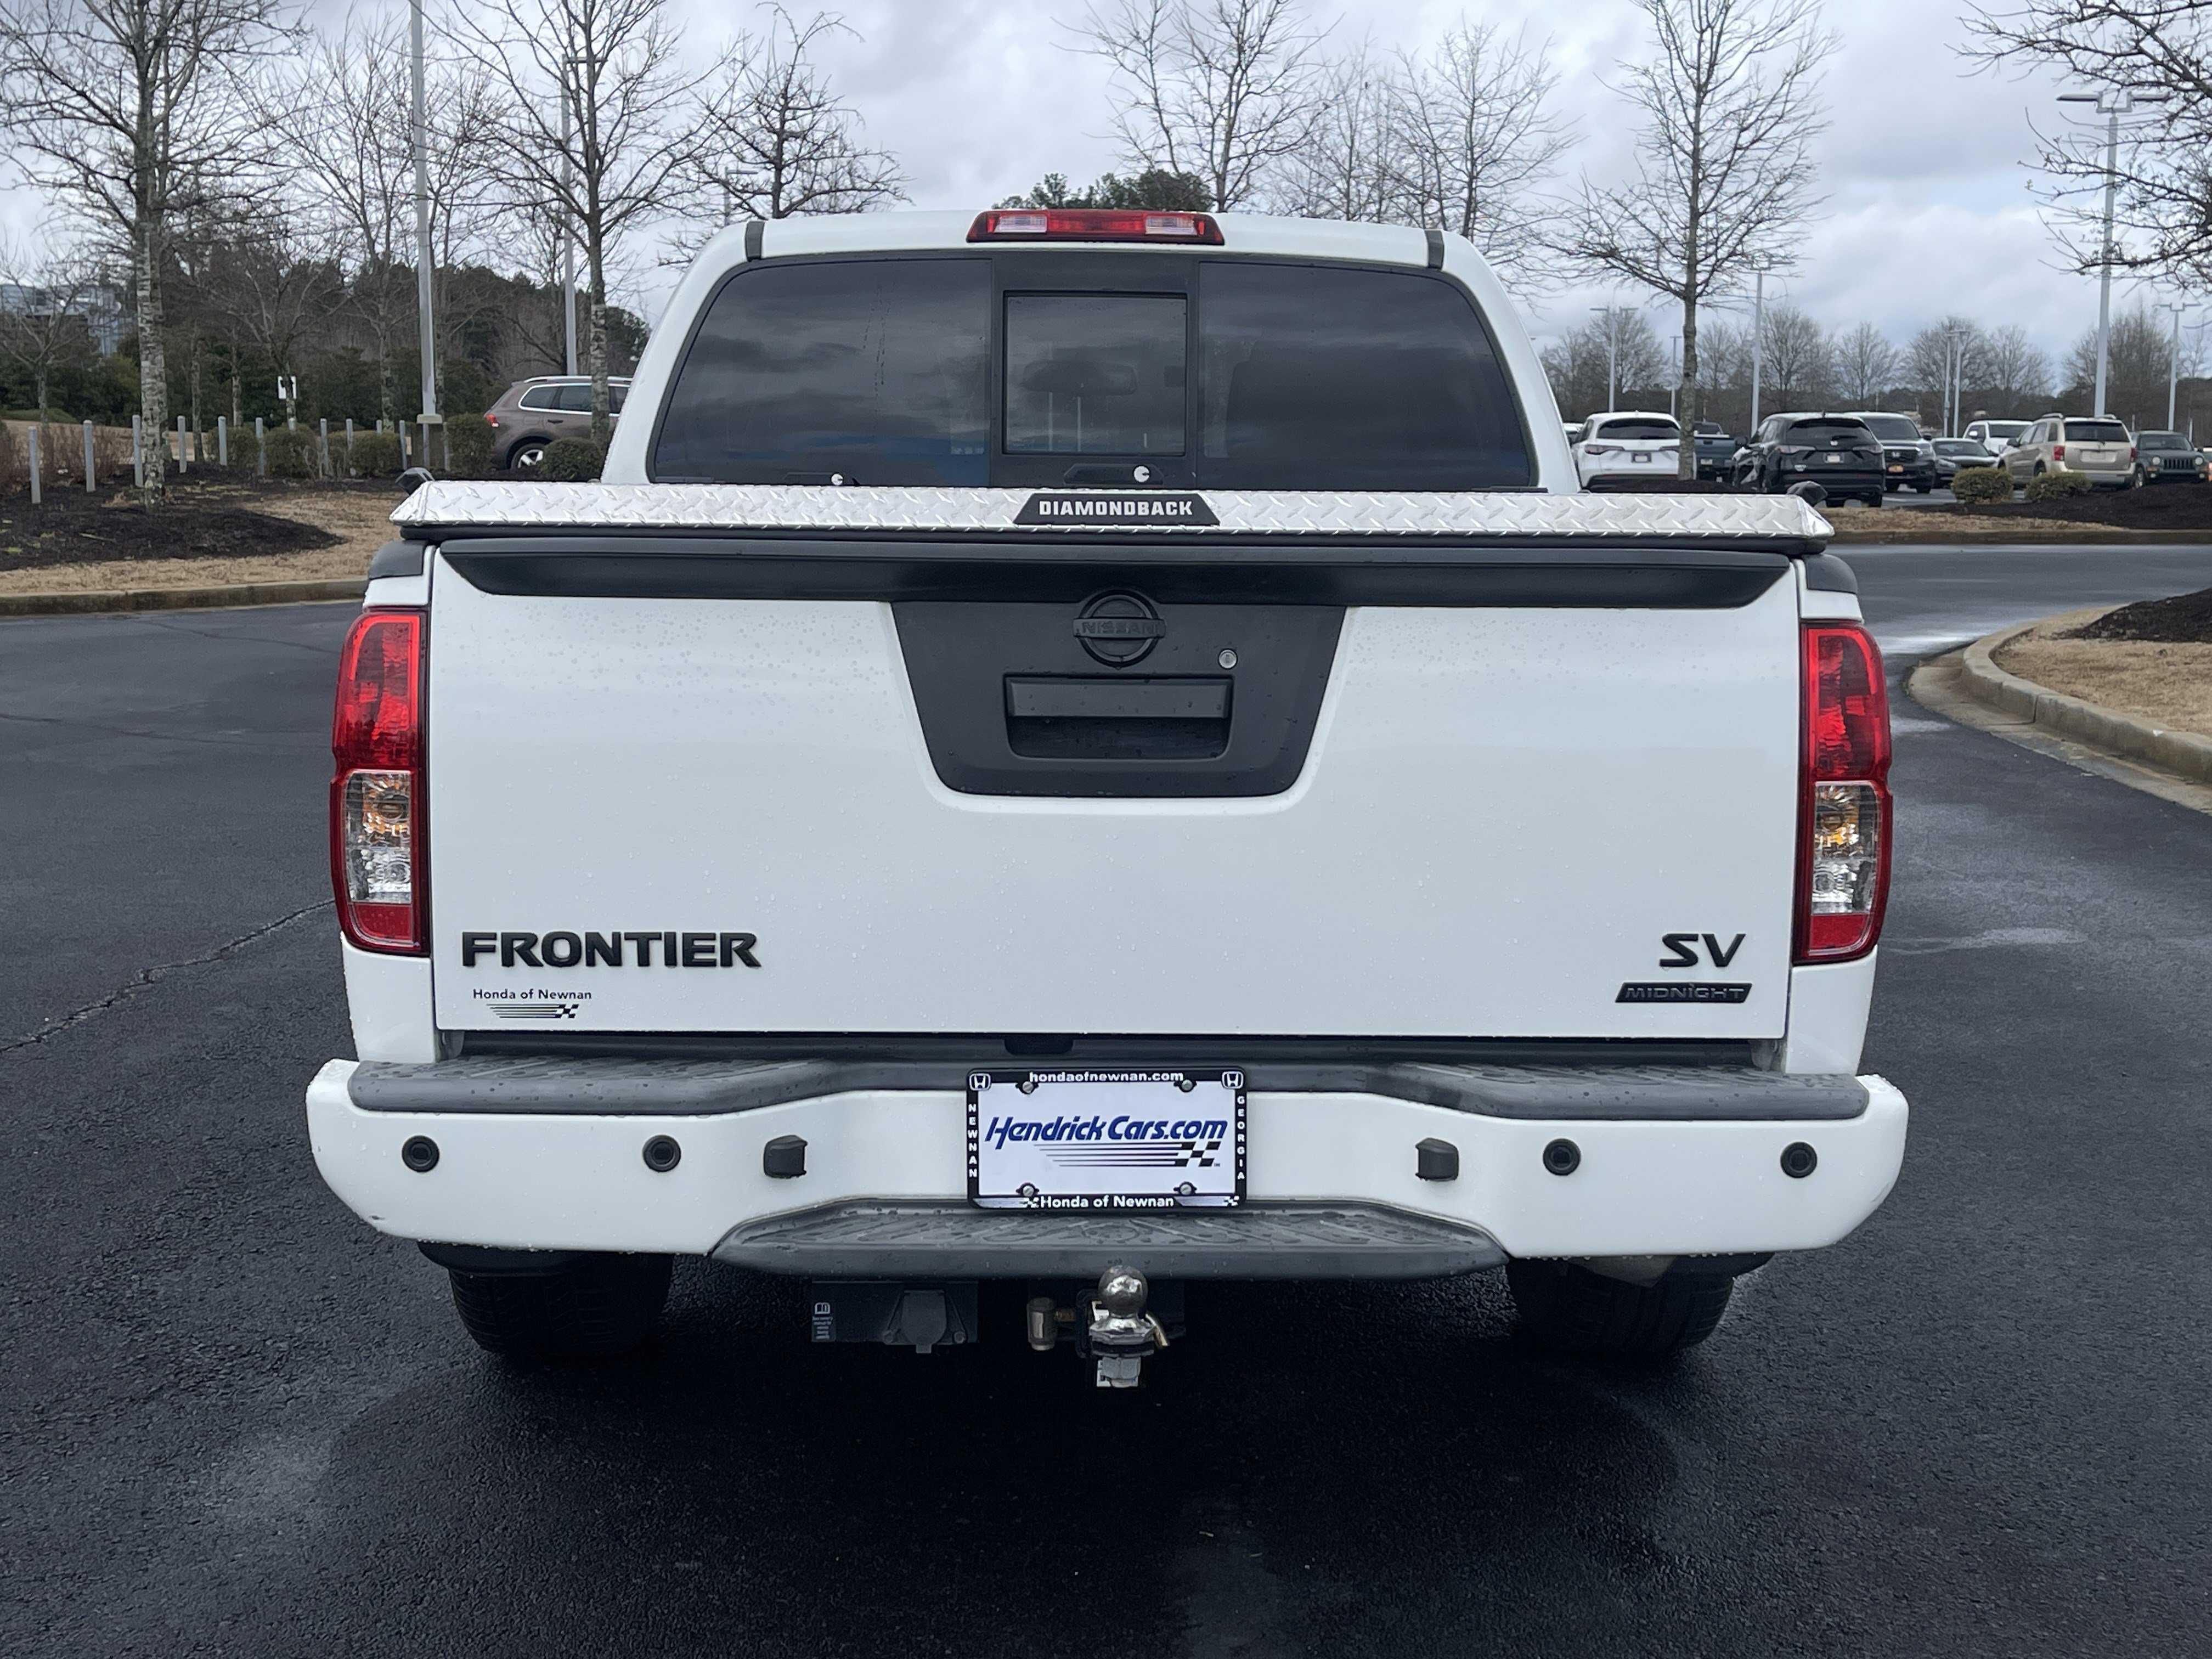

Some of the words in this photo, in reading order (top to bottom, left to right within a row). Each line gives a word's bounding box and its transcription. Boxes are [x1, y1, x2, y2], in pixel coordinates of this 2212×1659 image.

[1039, 501, 1193, 516] DIAMONDBACK
[462, 932, 761, 967] FRONTIER
[1659, 933, 1746, 967] SV
[473, 989, 516, 1000] Honda
[520, 989, 533, 999] of
[538, 989, 592, 1000] Newnan
[1625, 987, 1744, 999] MIDNIGHT
[1029, 1071, 1184, 1082] hondaofnewnan.com
[968, 1103, 978, 1178] NEWNAN
[1237, 1096, 1245, 1180] GEORGIA
[1041, 1196, 1090, 1208] Honda
[1093, 1195, 1110, 1208] of
[1114, 1196, 1174, 1207] Newnan
